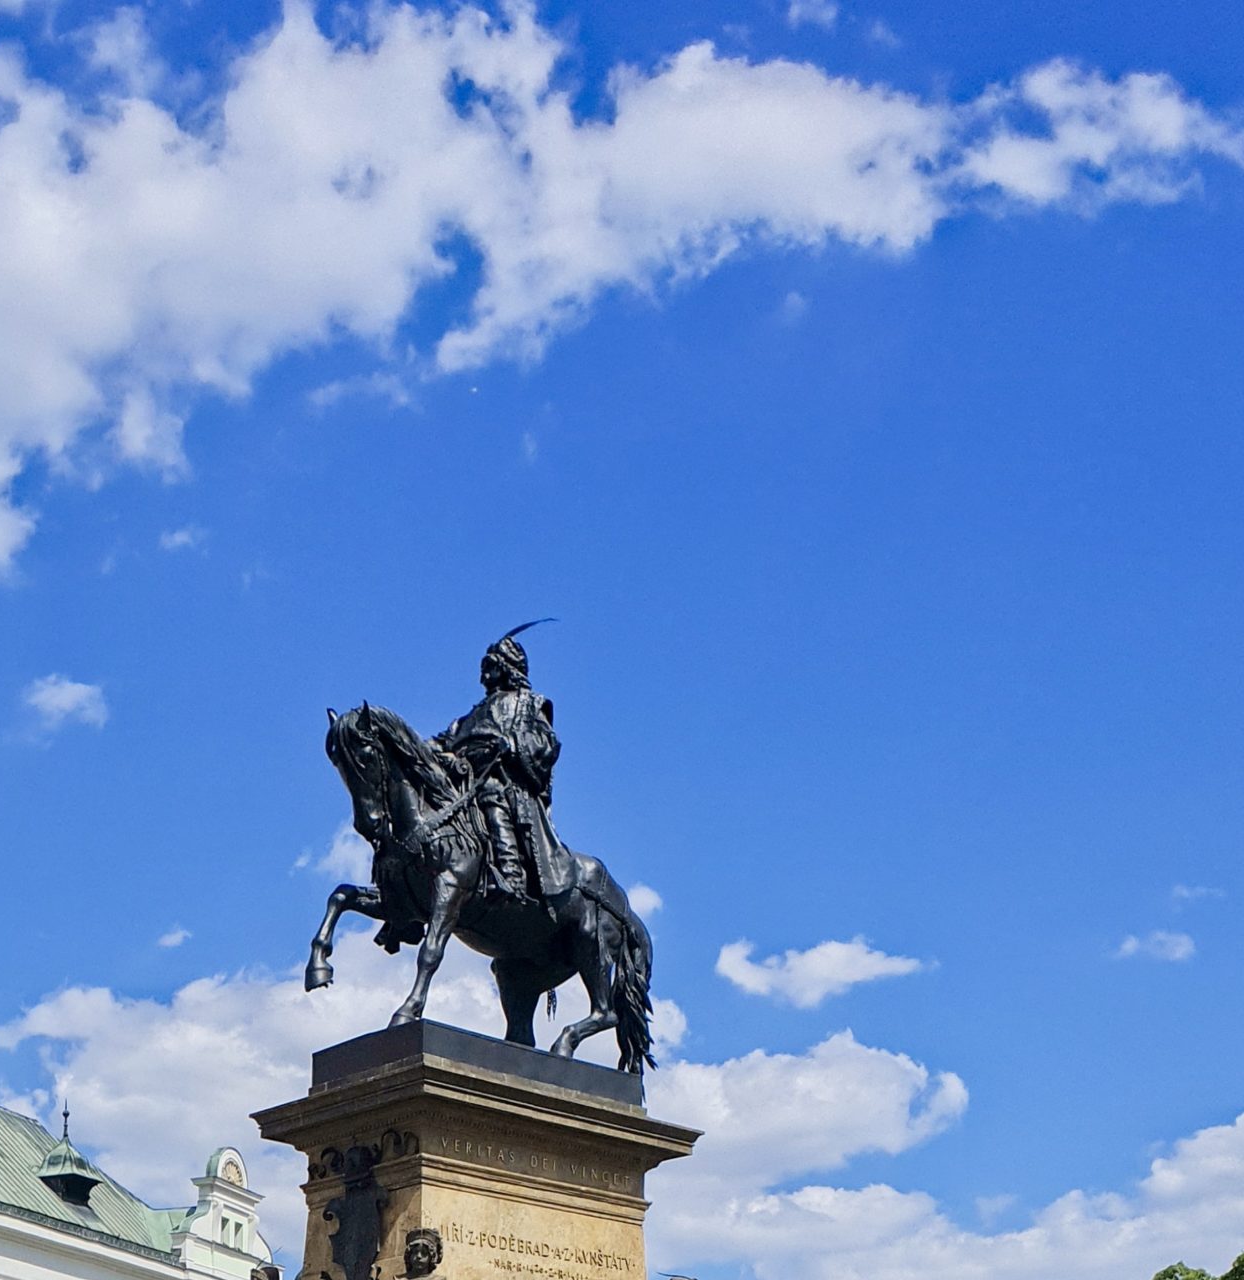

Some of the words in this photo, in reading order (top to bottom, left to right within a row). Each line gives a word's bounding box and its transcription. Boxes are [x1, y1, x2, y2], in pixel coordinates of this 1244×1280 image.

[441, 1137, 515, 1163] VERITAS
[531, 1155, 556, 1170] DEI
[570, 1165, 631, 1187] VINCET
